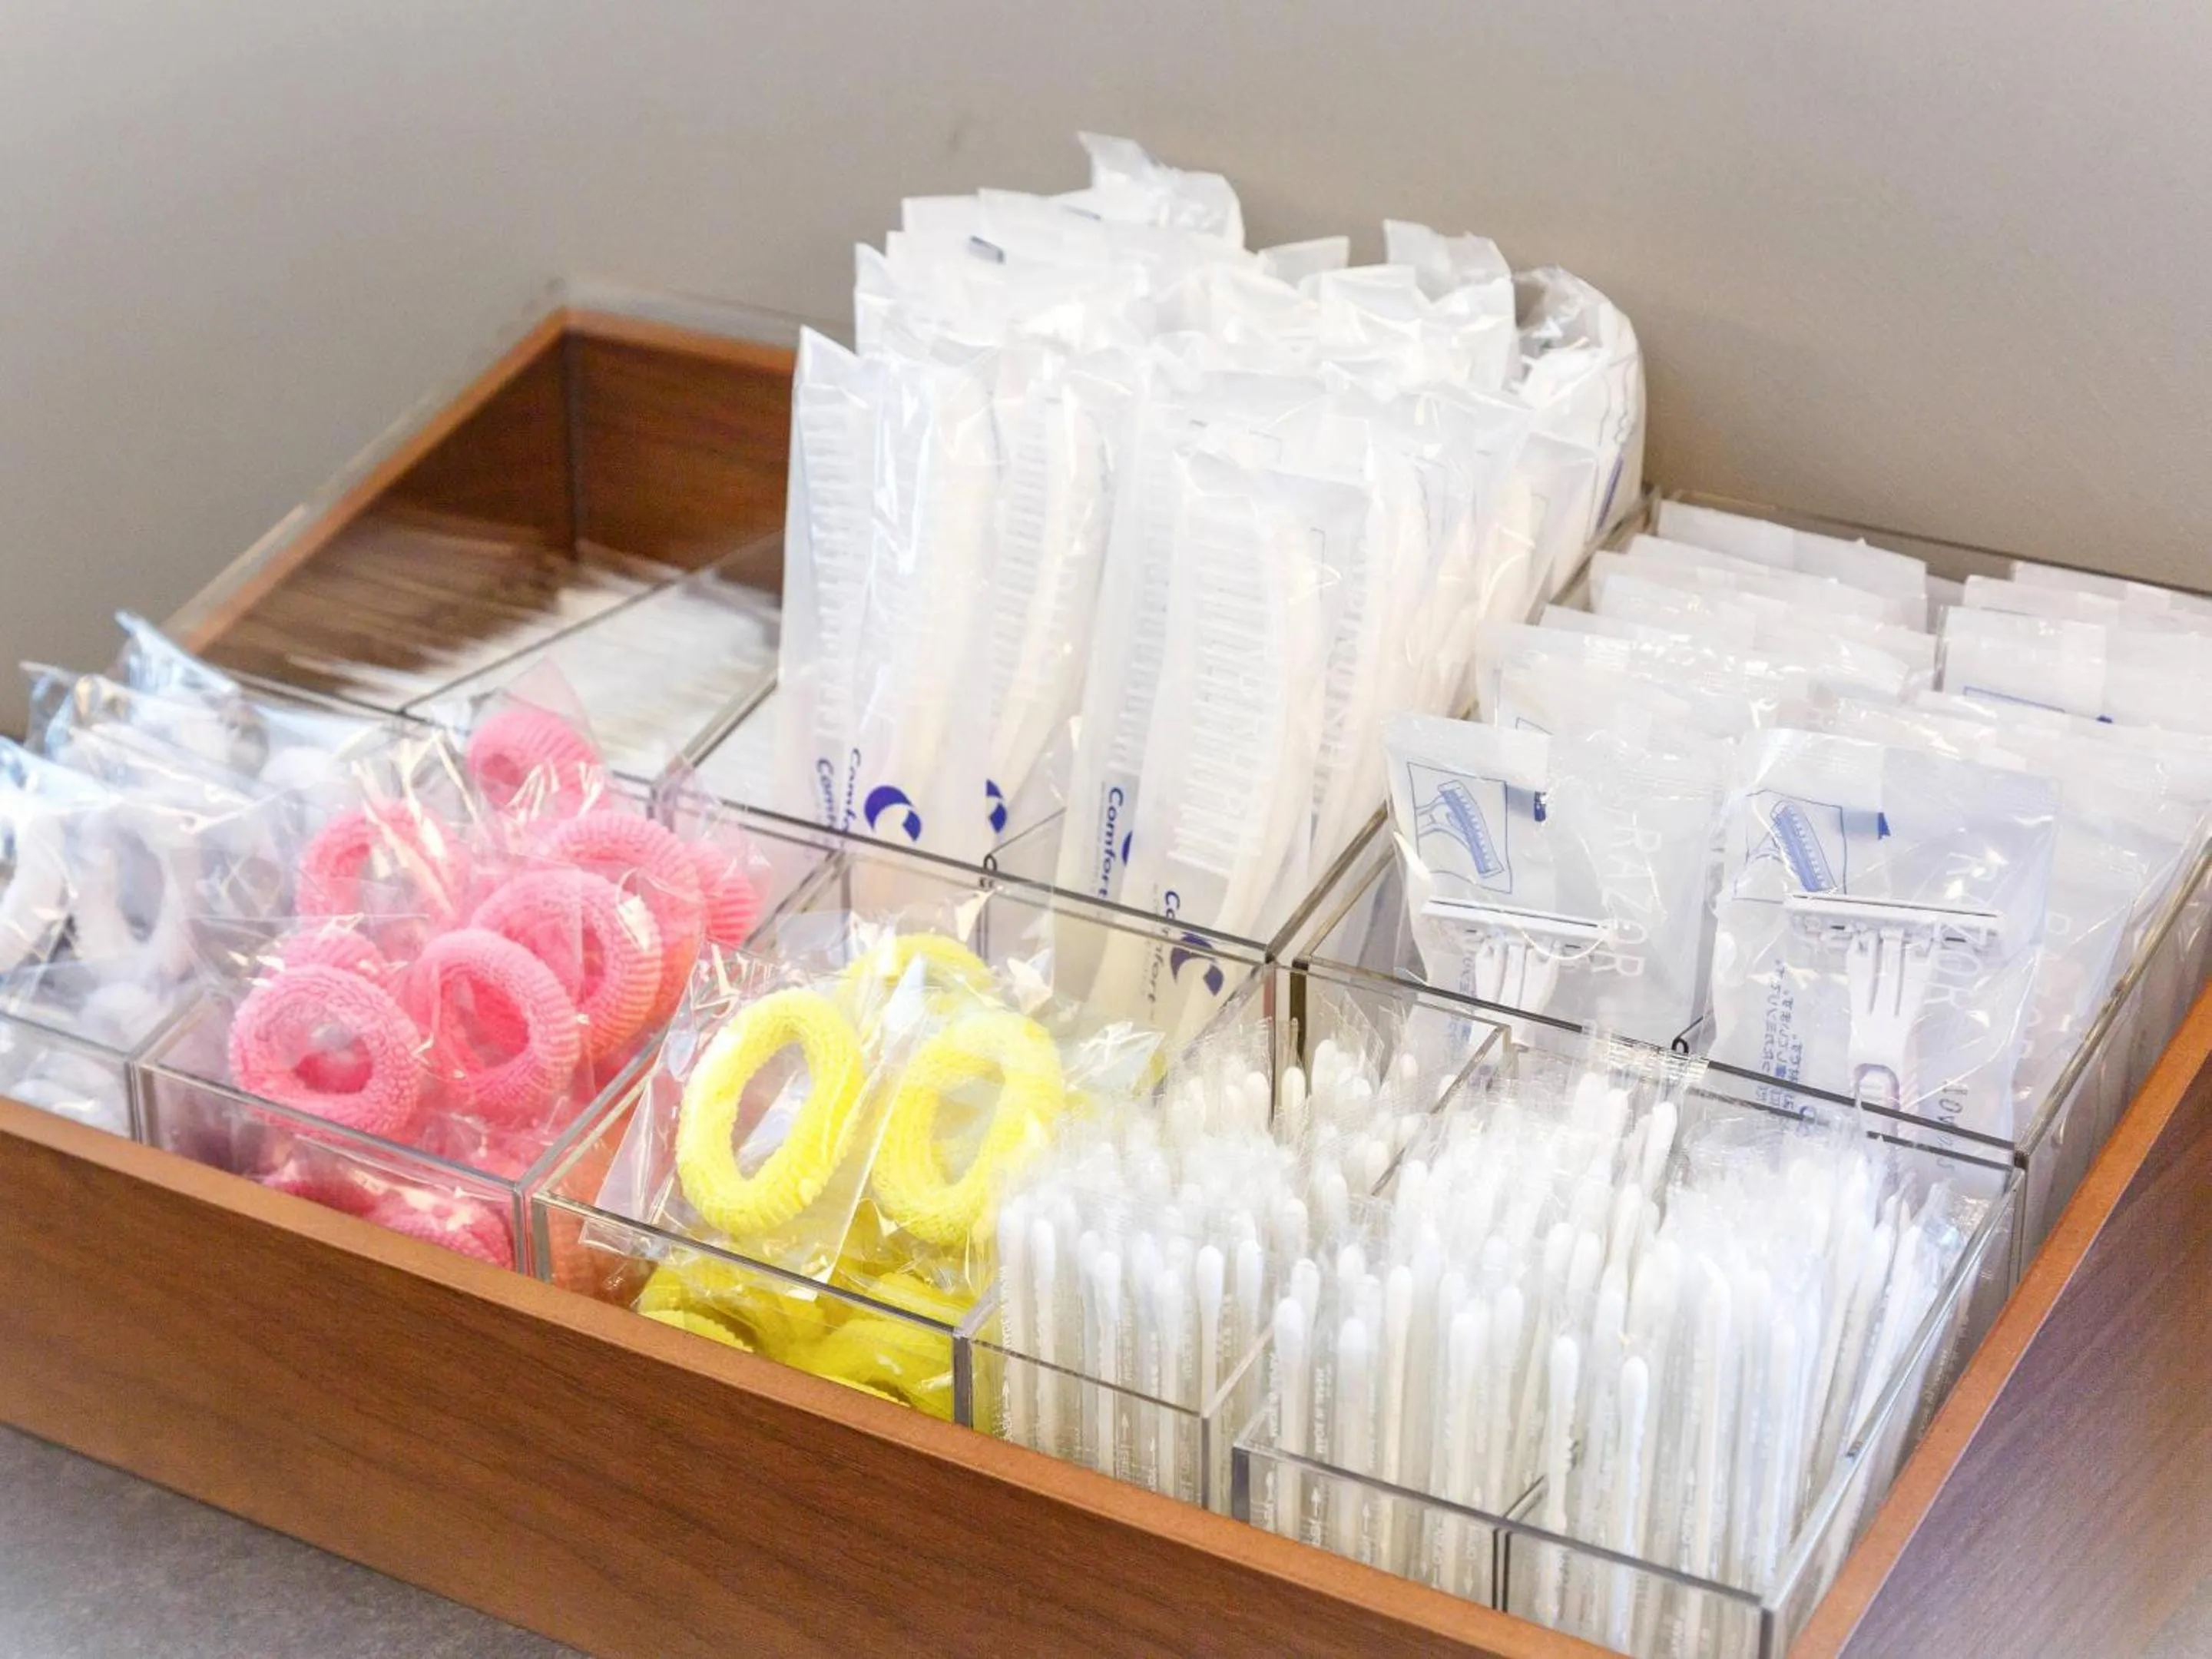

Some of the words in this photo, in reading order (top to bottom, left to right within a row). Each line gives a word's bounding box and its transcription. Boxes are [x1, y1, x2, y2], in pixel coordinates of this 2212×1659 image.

[840, 747, 862, 834] Comfo
[1098, 786, 1125, 899] Comfort
[1590, 826, 1663, 978] RAZOR
